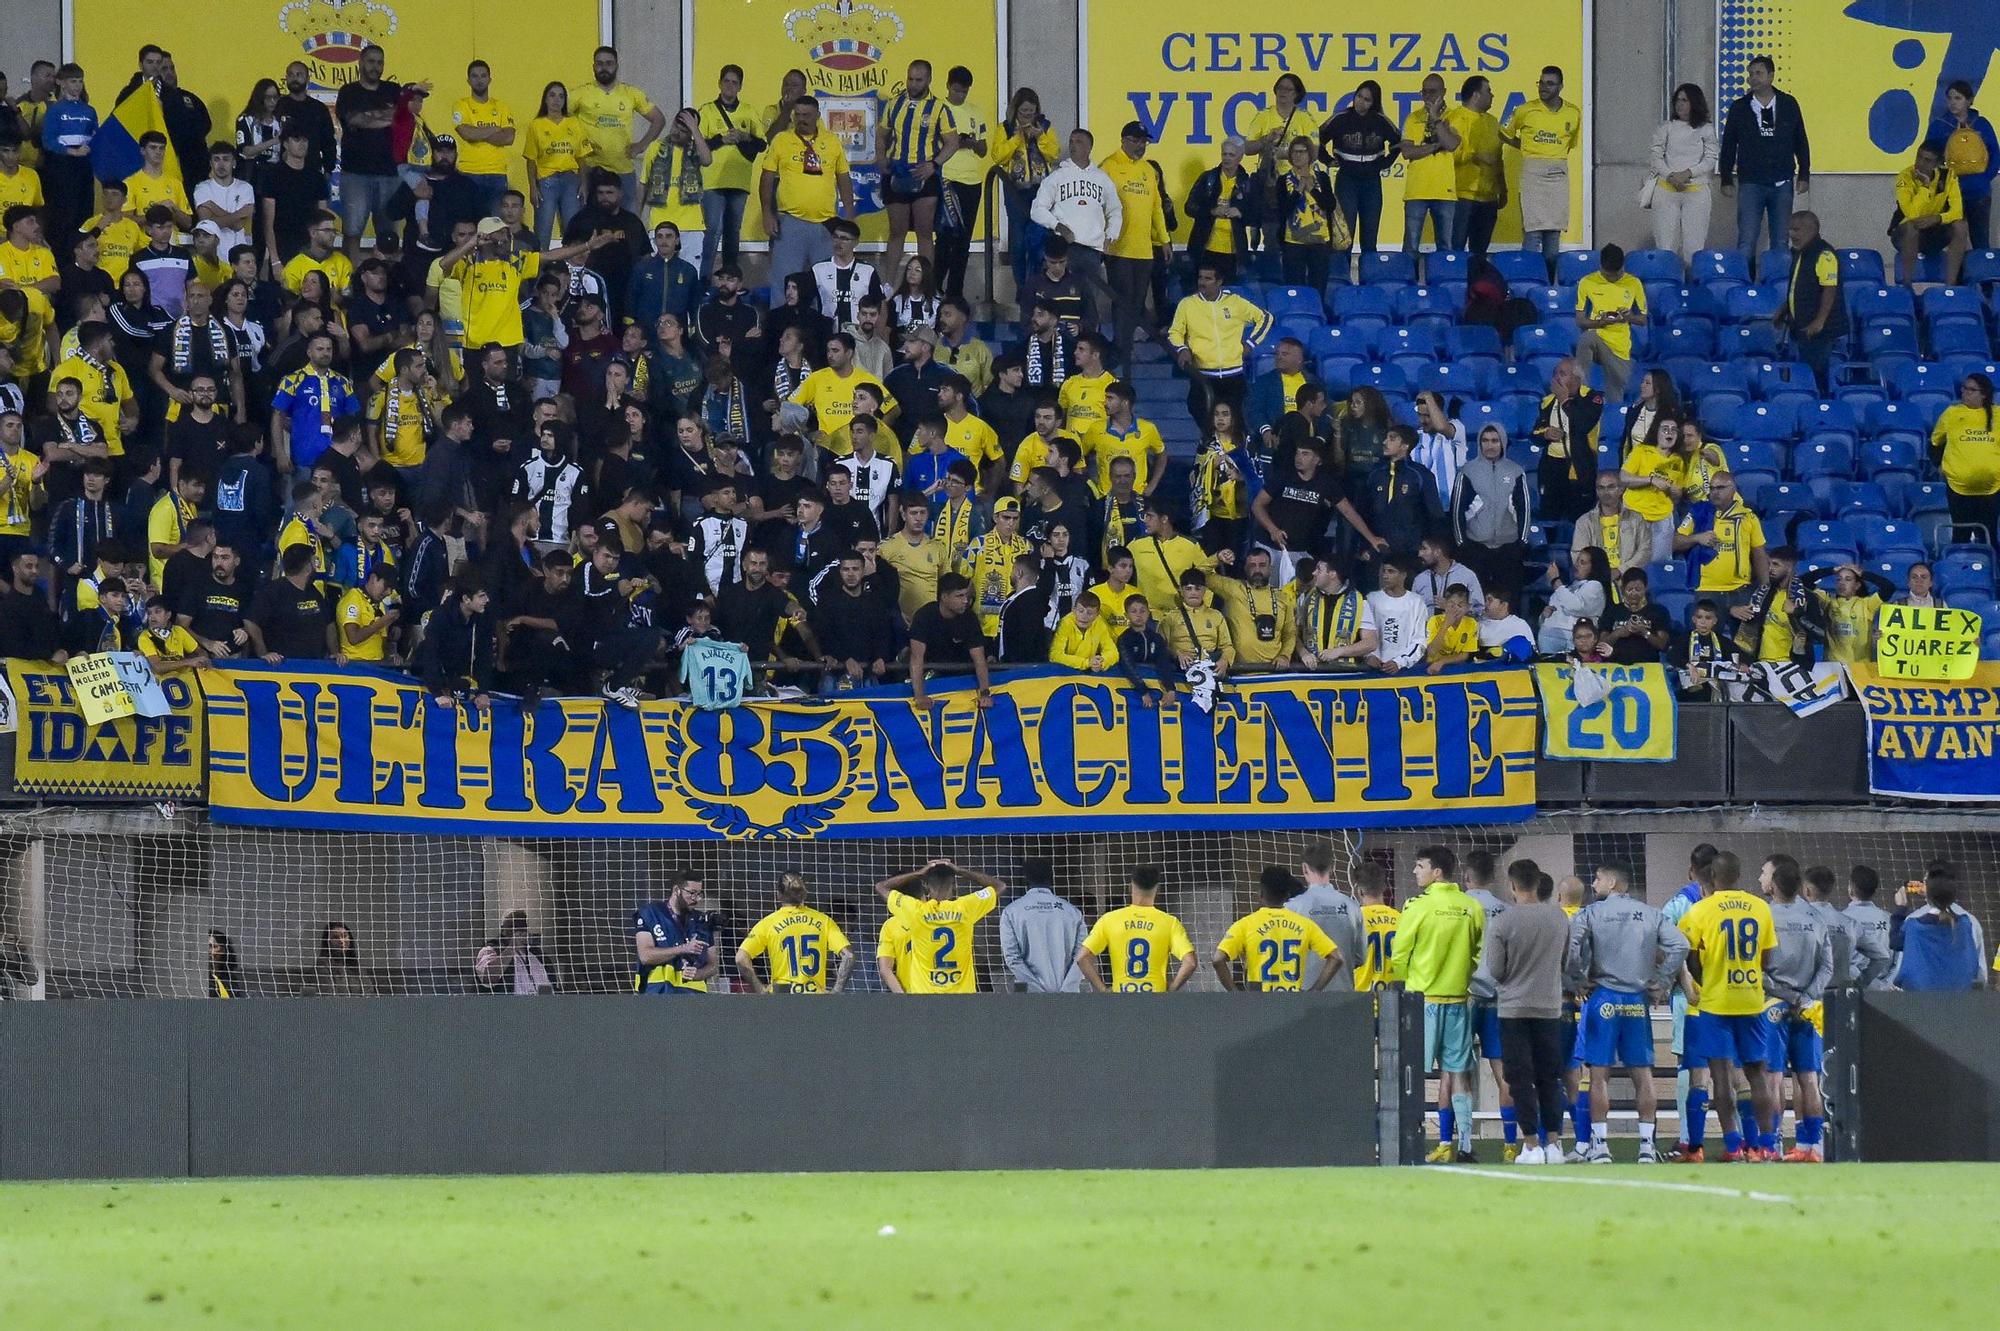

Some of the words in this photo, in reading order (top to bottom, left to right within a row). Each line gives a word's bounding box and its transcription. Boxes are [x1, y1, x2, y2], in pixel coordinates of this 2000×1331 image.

[1162, 32, 1510, 73] CERVEZAS
[838, 67, 889, 92] PALMAS
[1533, 137, 1564, 145] Canaria
[1538, 130, 1558, 139] Gran
[1059, 180, 1103, 202] ELLESSE
[1126, 180, 1146, 189] Gran
[173, 315, 193, 368] ULTRA
[1959, 434, 1995, 443] Canaria
[1965, 428, 1989, 436] Gran
[1886, 609, 1978, 635] ALEX
[1881, 634, 1972, 657] SUAREZ
[71, 657, 114, 675] ALBERTO
[90, 680, 142, 699] CAMISETA
[703, 666, 738, 701] 13
[1566, 685, 1651, 749] 20
[234, 679, 664, 814] ULTRA
[685, 705, 843, 797] 85
[866, 680, 1506, 813] NACIENTE
[923, 911, 963, 923] MARVIN
[1124, 920, 1154, 932] FABIO
[1256, 919, 1303, 937] KAPTOUM
[932, 927, 957, 969] 2
[1720, 918, 1759, 962] 18
[781, 934, 820, 977] 15
[1127, 938, 1150, 979] 8
[1259, 939, 1303, 982] 25
[1727, 969, 1758, 984] IOC
